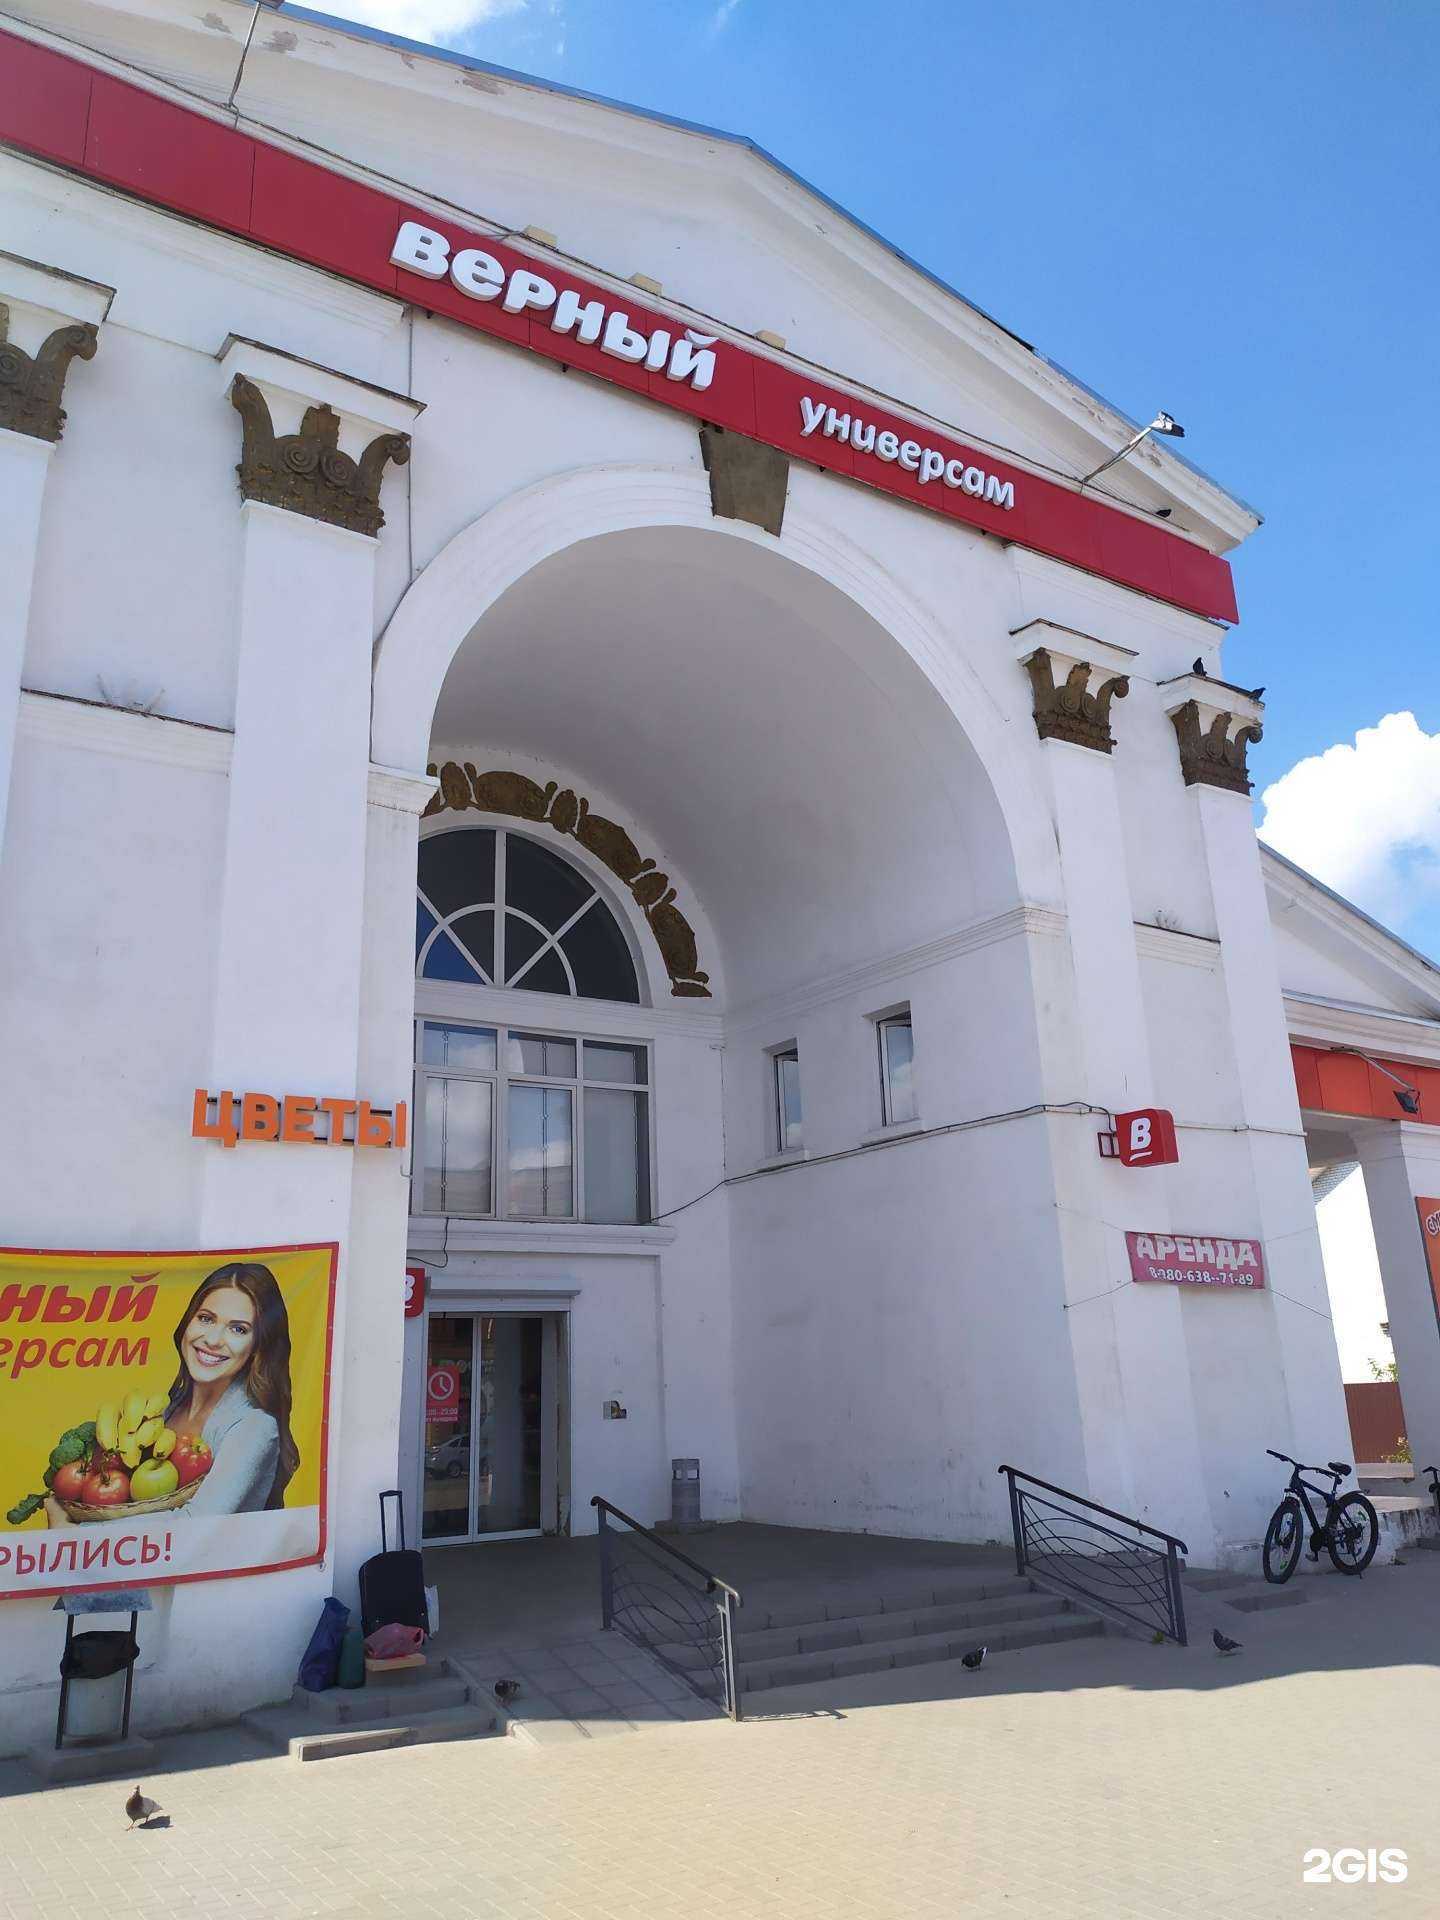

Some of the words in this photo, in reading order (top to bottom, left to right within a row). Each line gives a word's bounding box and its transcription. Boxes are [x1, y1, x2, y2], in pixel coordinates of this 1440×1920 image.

[800, 397, 1015, 510] универсам
[192, 1088, 407, 1148] ЦВЕТЫ
[1136, 1234, 1258, 1270] АРЕНДА
